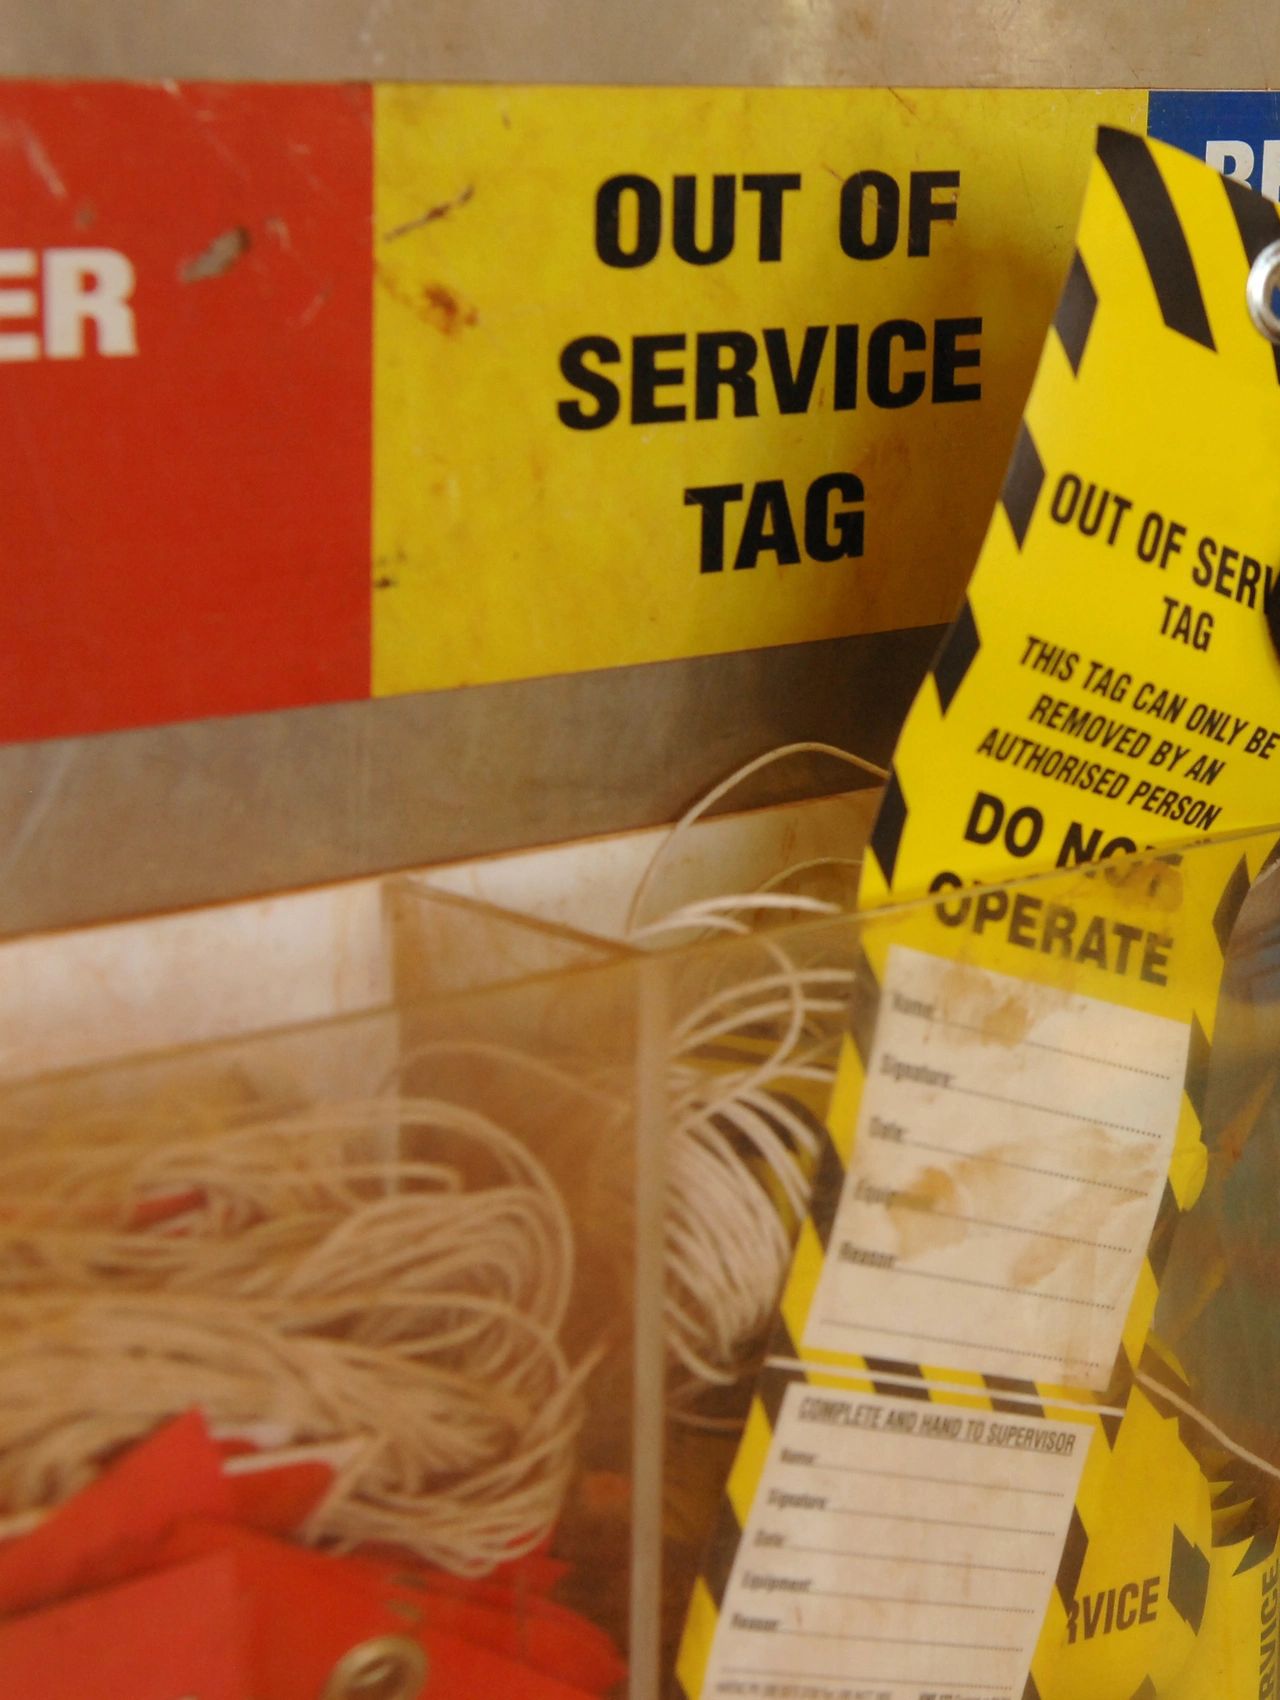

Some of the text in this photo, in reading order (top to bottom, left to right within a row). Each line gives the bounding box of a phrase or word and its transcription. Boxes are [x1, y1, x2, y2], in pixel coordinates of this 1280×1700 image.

[594, 169, 961, 271] OUT OF
[555, 316, 983, 432] SERVICE
[683, 471, 866, 574] TAG
[1049, 473, 1132, 547] OUT
[1136, 512, 1187, 571] OF
[1161, 596, 1214, 653] TAG
[1019, 635, 1081, 683] THIS
[1082, 660, 1132, 703] TAG
[1132, 682, 1188, 724] CAN
[1185, 704, 1249, 747] ONLY
[1028, 694, 1227, 787] REMOVED BY AN
[963, 790, 1044, 858] DO
[976, 727, 1223, 832] AUTHORISED PERSON
[928, 871, 1174, 988] OPERATE
[798, 1396, 1077, 1455] COMPLETE AND HAND TO SUPERVISOR
